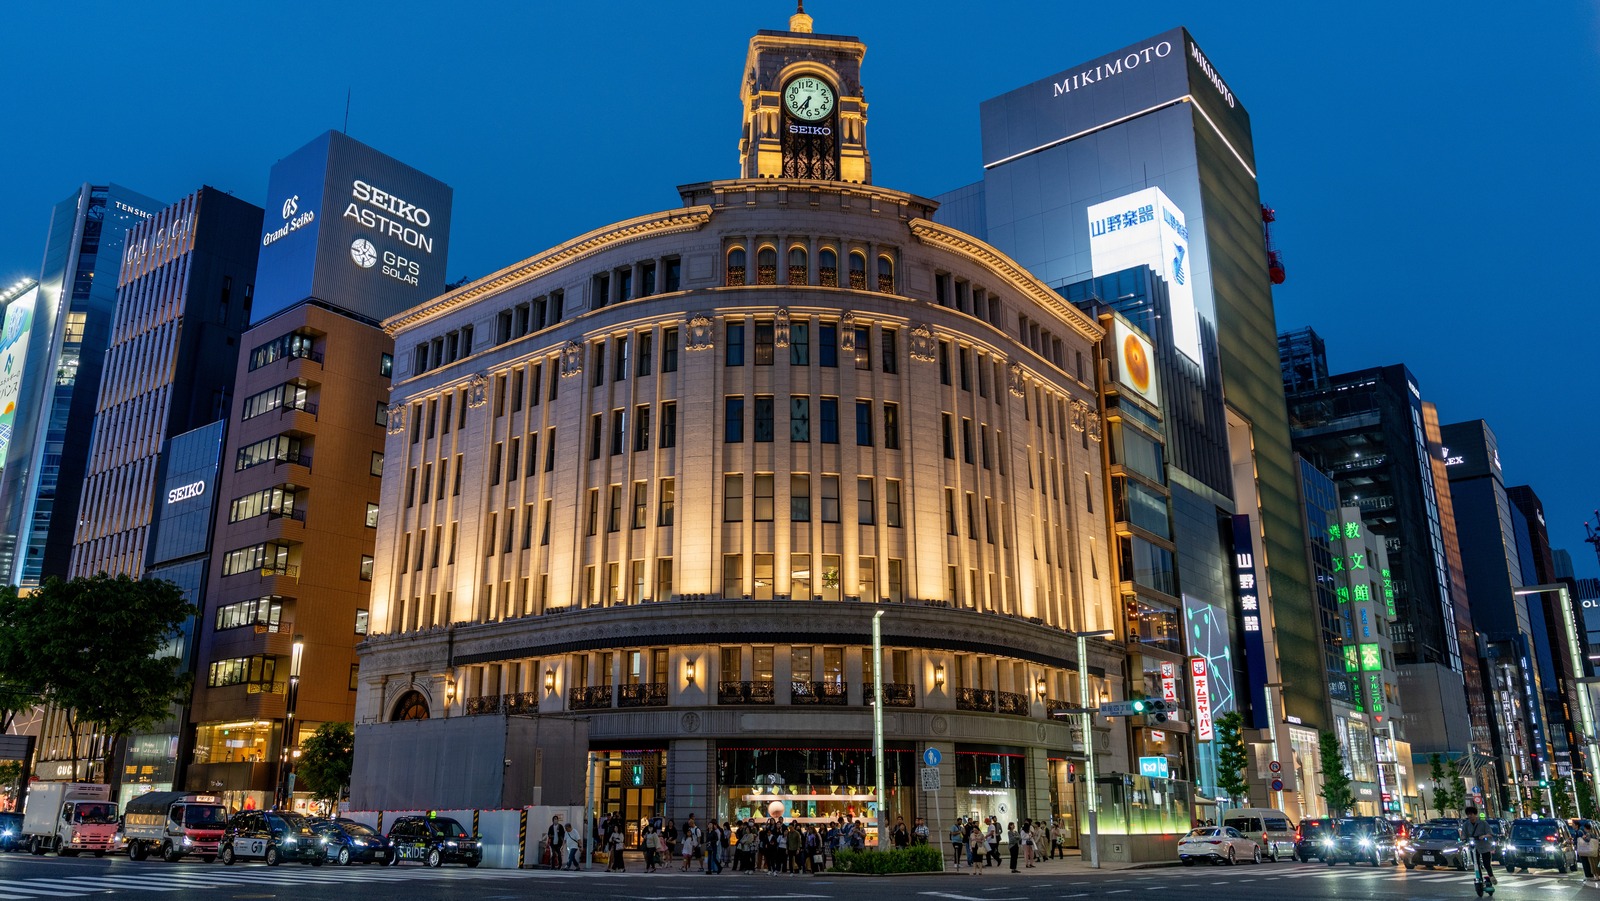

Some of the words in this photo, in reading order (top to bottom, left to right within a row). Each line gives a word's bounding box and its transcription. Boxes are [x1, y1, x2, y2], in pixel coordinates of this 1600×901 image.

[1053, 40, 1172, 98] MIKIMOTO
[1190, 41, 1235, 109] MIKIMOTO
[798, 81, 804, 89] 11
[820, 88, 826, 96] 2
[806, 109, 812, 117] 6
[789, 125, 831, 136] SEIKO
[282, 194, 299, 220] GS
[352, 179, 431, 227] SEIKO
[263, 223, 290, 247] Grand
[290, 210, 315, 233] Seiko
[343, 202, 433, 254] ASTRON
[1090, 204, 1155, 238] 山野楽器
[382, 265, 419, 287] SOLAR
[383, 250, 420, 276] GPS
[168, 480, 205, 504] SEIKO
[1344, 521, 1369, 601] 教文館
[1236, 553, 1260, 631] 山野楽器
[1582, 599, 1600, 608] OL
[1195, 679, 1211, 736] キムラヤのパン
[57, 765, 81, 776] GUCI
[251, 841, 263, 854] GO
[399, 846, 425, 859] S.RIDE
